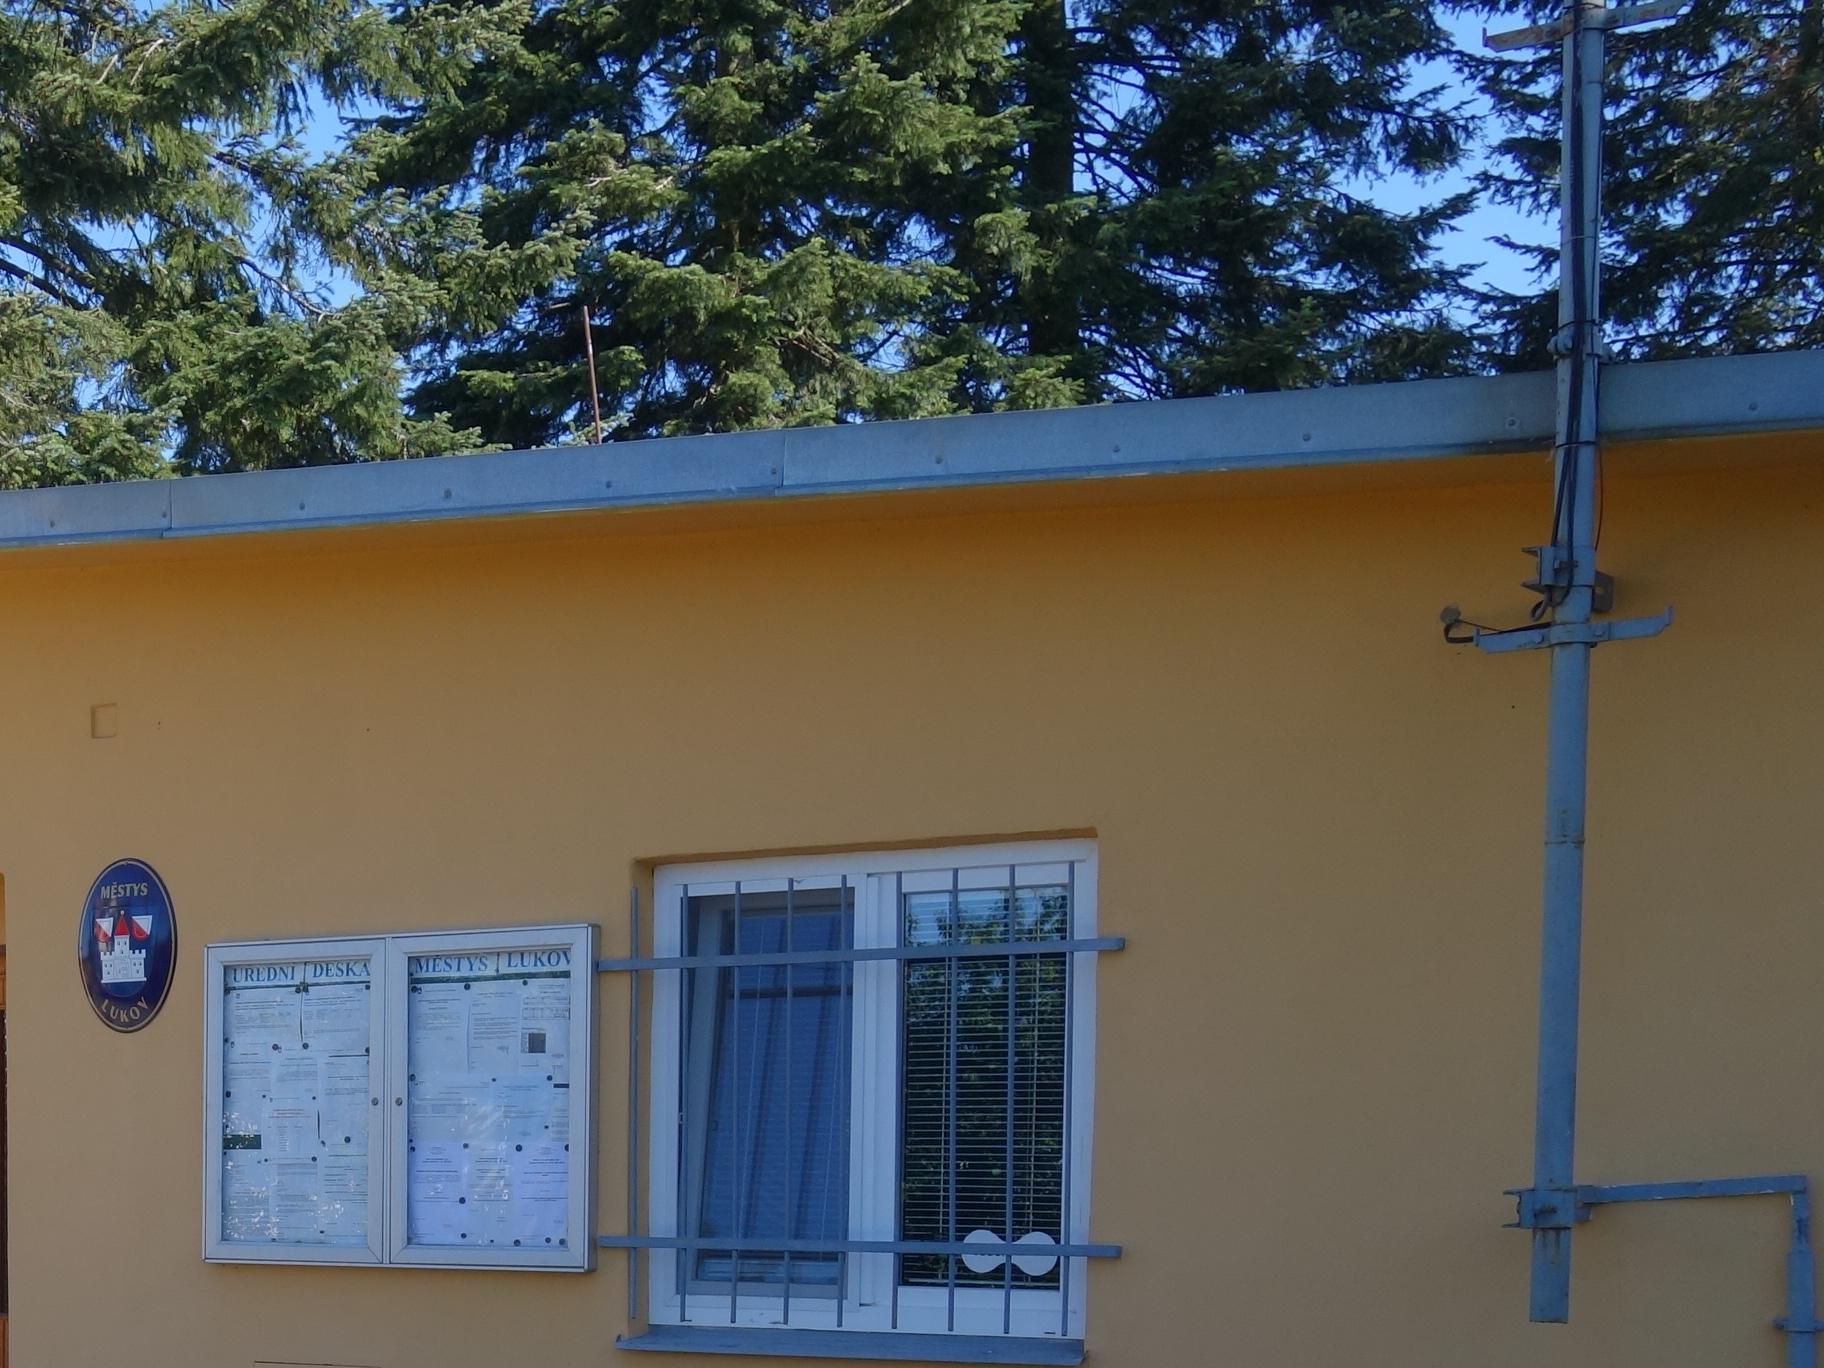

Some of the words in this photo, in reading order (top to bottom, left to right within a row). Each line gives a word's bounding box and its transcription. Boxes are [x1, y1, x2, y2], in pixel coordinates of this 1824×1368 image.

[100, 881, 148, 899] MĚSTYS
[507, 950, 571, 968] LUKOV
[312, 961, 371, 978] DESKA
[101, 996, 148, 1023] LUKOV
